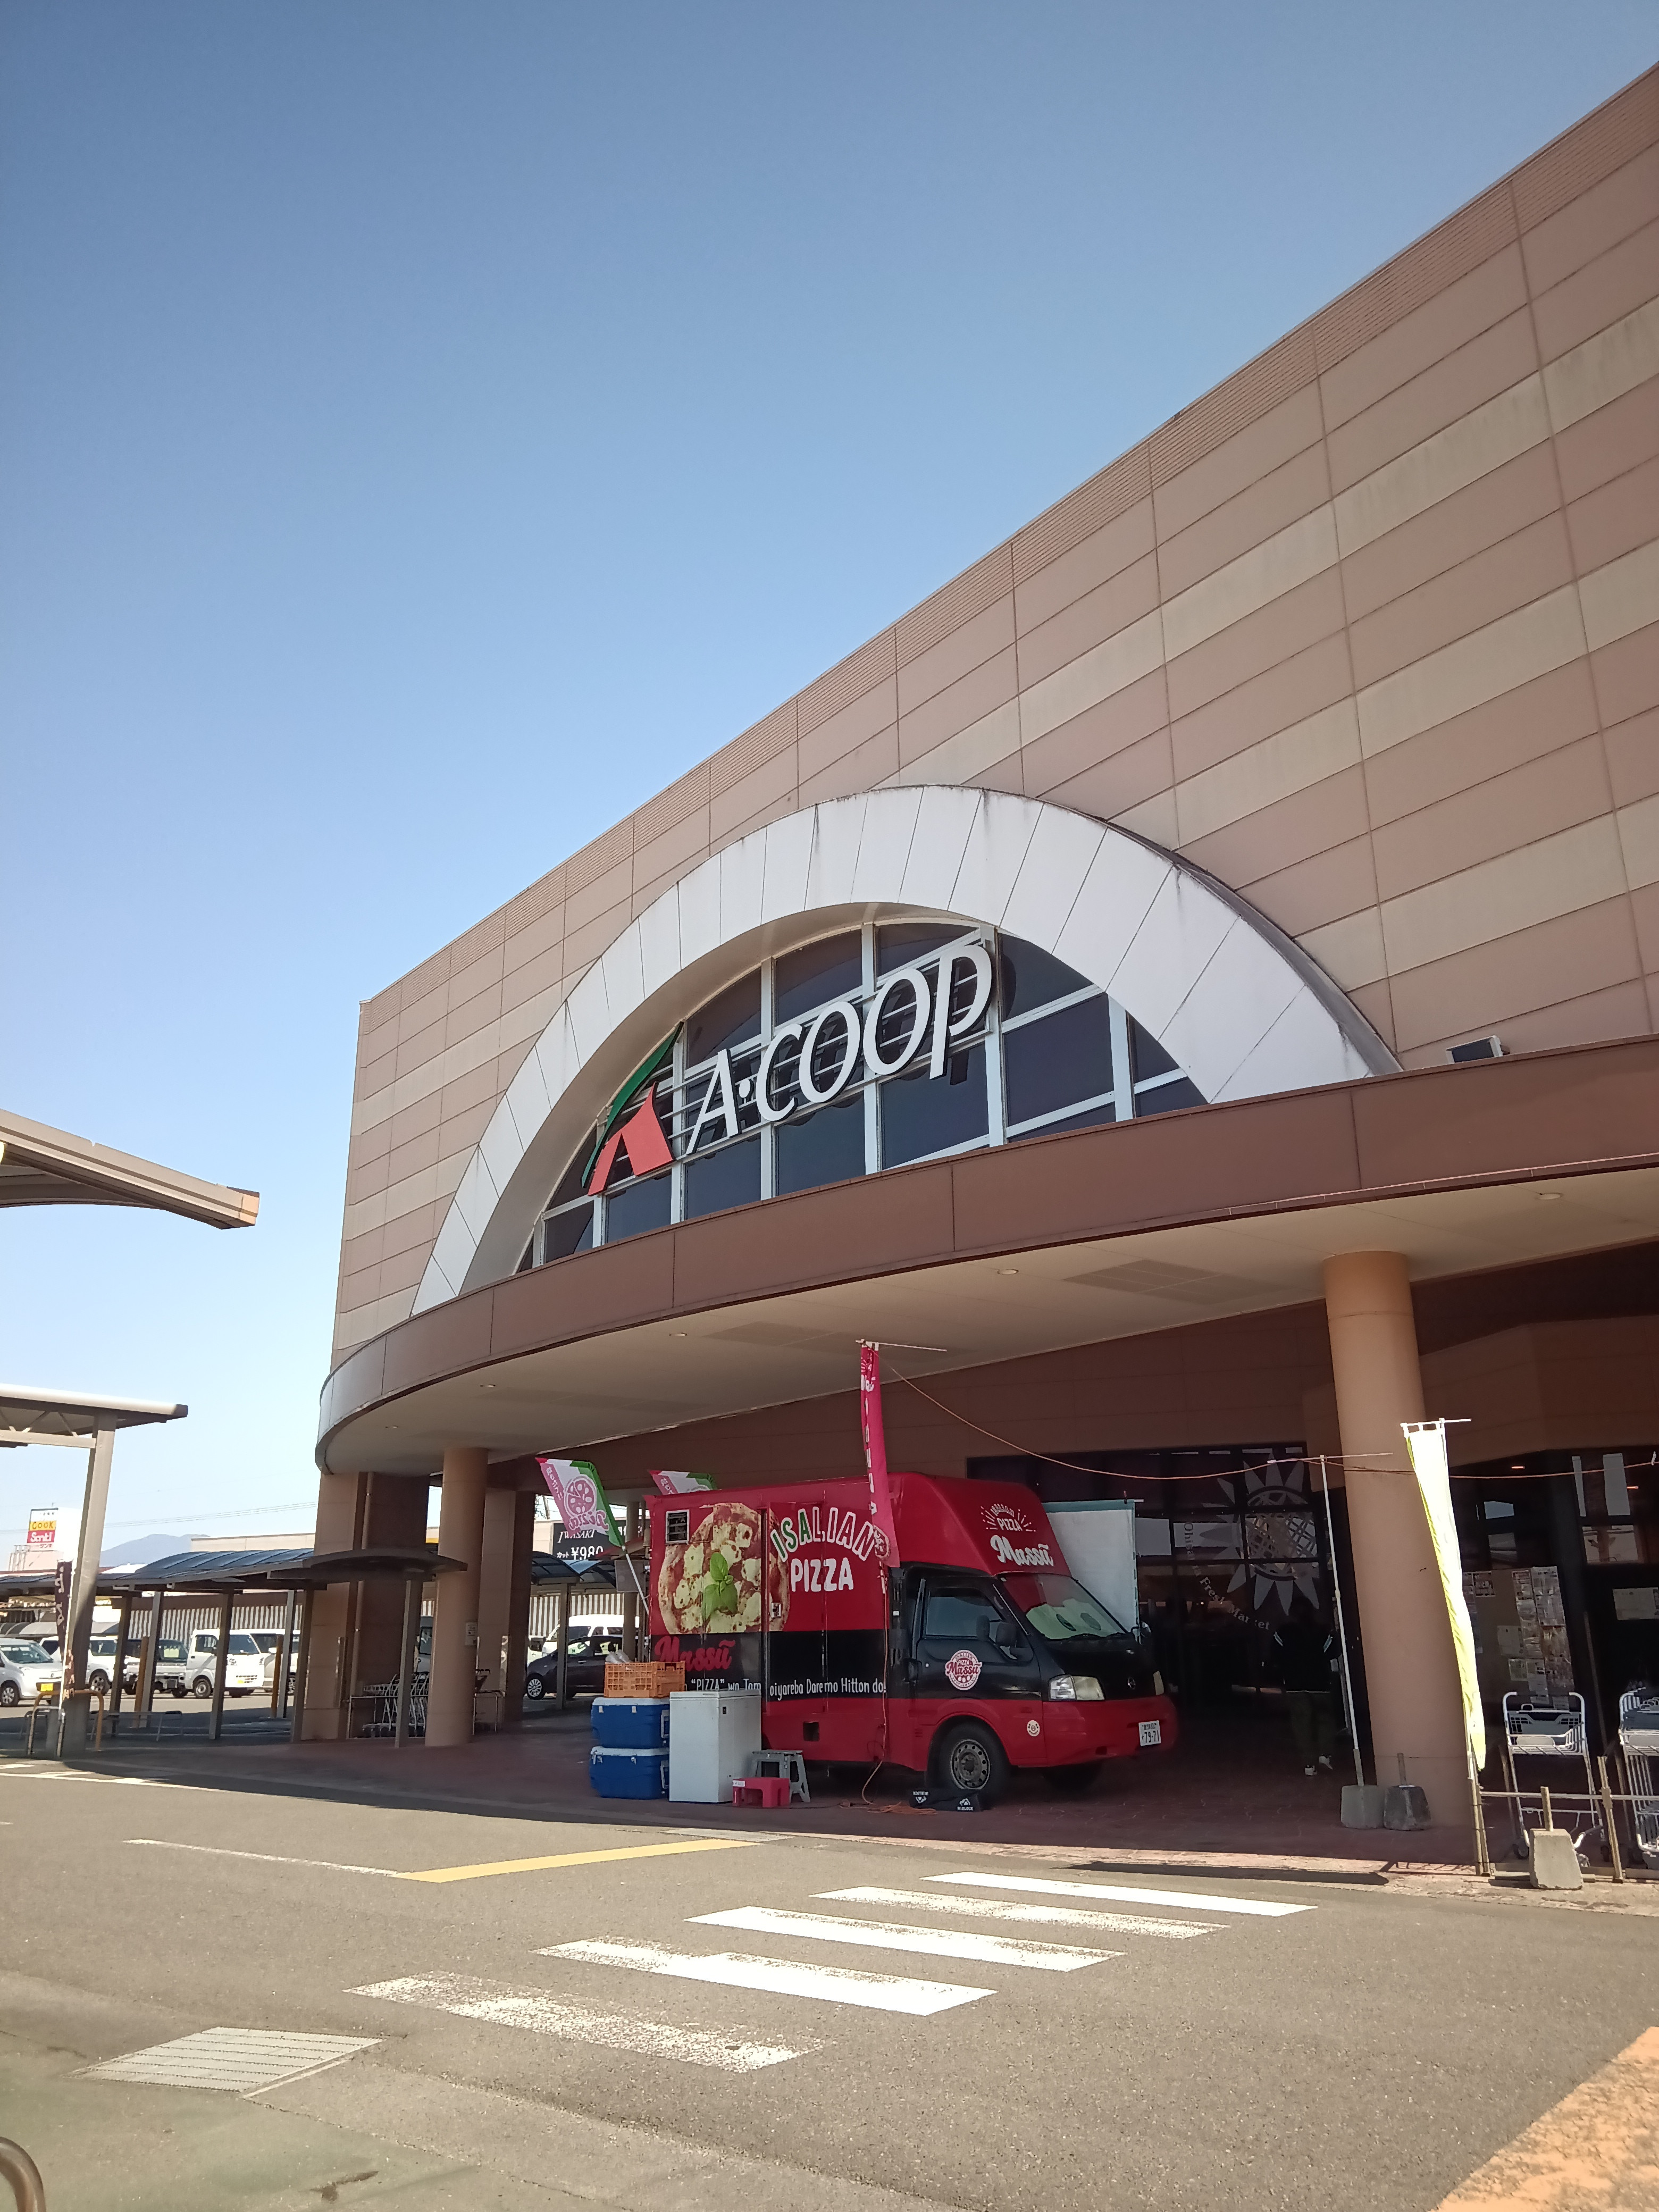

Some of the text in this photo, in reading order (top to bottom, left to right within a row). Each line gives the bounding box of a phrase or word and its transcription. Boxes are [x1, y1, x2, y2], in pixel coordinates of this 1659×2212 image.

[770, 1506, 875, 1562] ISALIAN
[996, 1518, 1023, 1531] PIZZA
[1184, 1522, 1202, 1577] Ohisaa
[791, 1557, 854, 1592] PIZZA
[841, 1678, 870, 1693] Hitton
[872, 1678, 886, 1693] do!
